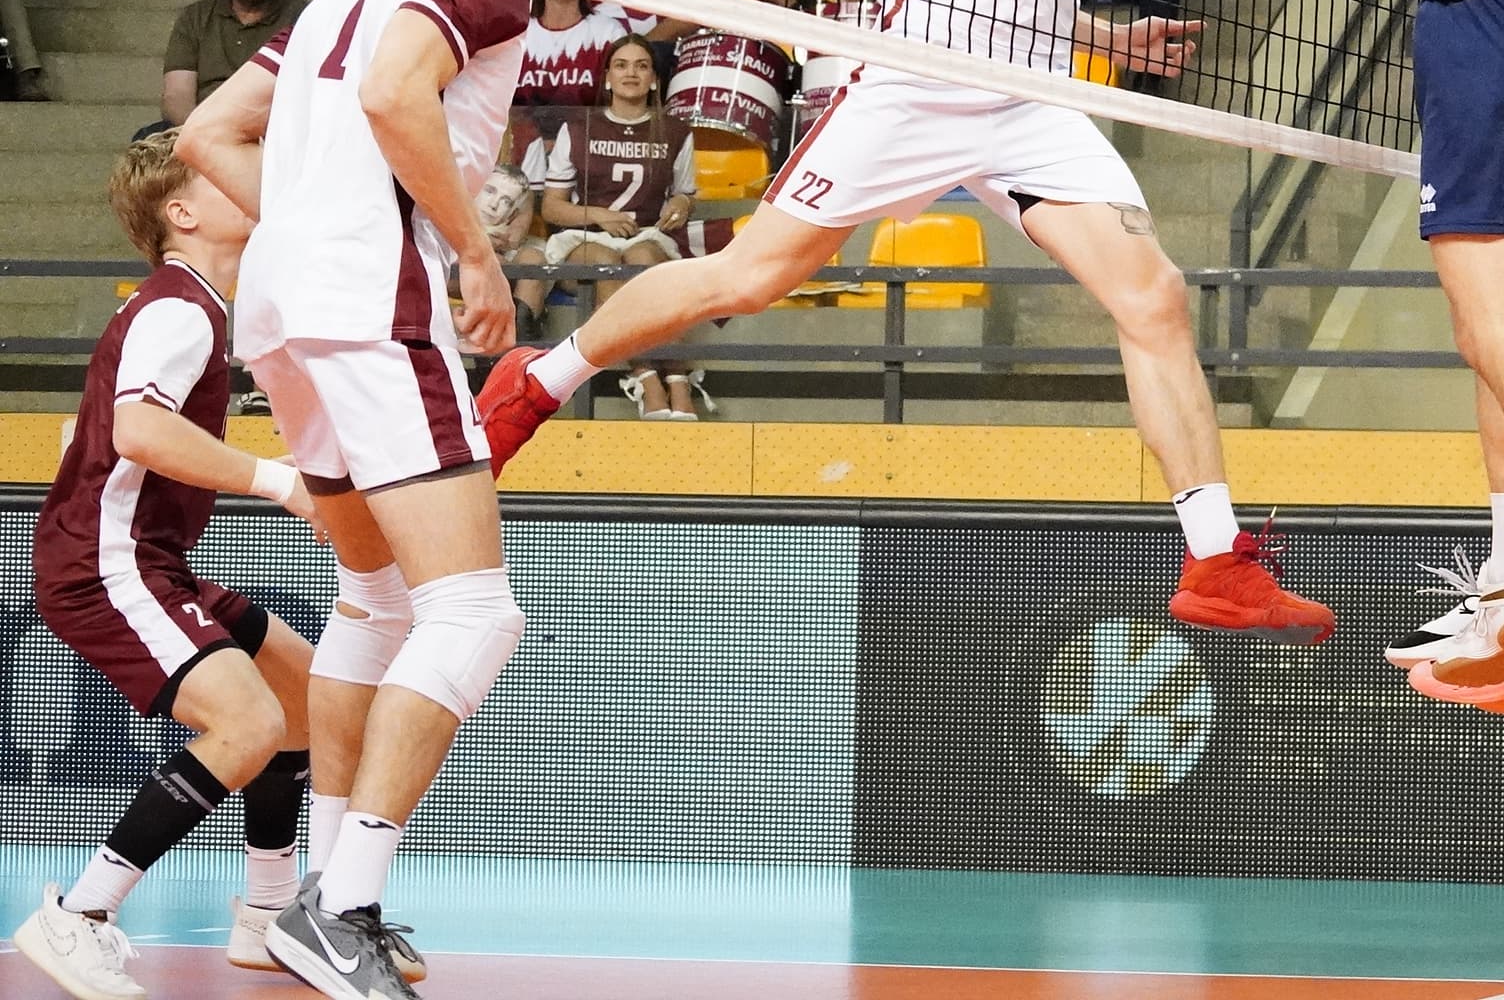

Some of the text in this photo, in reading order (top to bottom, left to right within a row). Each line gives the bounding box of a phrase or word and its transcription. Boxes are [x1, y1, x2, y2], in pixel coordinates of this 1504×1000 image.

[589, 139, 669, 160] KRONBERGS
[608, 162, 644, 221] 2
[790, 170, 834, 210] 22
[181, 602, 214, 627] 2
